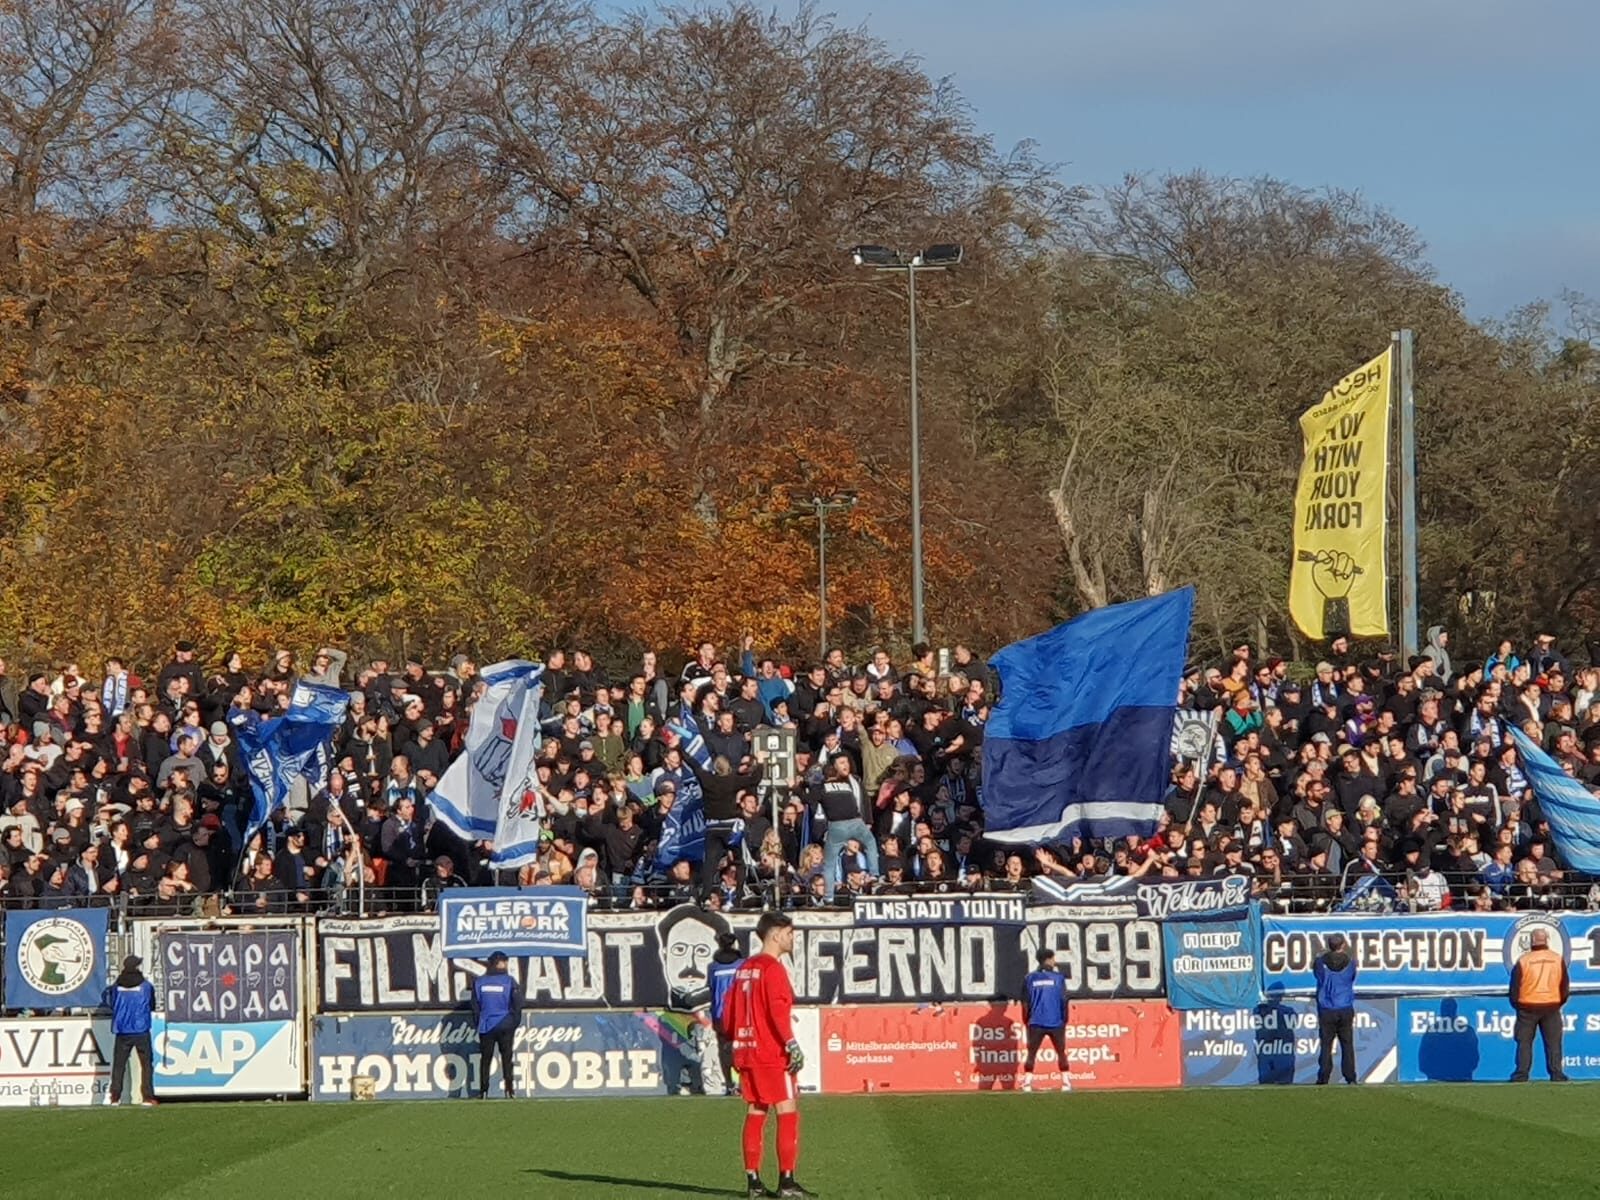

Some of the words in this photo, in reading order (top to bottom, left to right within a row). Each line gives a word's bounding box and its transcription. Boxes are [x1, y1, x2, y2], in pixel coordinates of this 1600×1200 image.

[458, 901, 569, 917] ALERTA
[854, 900, 954, 920] FILMSTADT
[960, 899, 1024, 921] YOUTH
[457, 915, 569, 932] NETWORK
[1020, 920, 1161, 991] 1999
[1203, 956, 1252, 972] IMMER!
[389, 1016, 481, 1045] Nulldr
[1186, 1010, 1277, 1035] Mitglied
[1284, 1012, 1376, 1030] wen.
[1411, 1011, 1468, 1033] Eine
[1476, 1011, 1515, 1038] Lig
[969, 1024, 1004, 1041] Das
[0, 1028, 110, 1068] VIA
[154, 1030, 256, 1076] SAP
[845, 1041, 958, 1052] Mittelbrandenburgische
[1254, 1039, 1295, 1055] Yalla
[846, 1053, 894, 1064] Sparkasse
